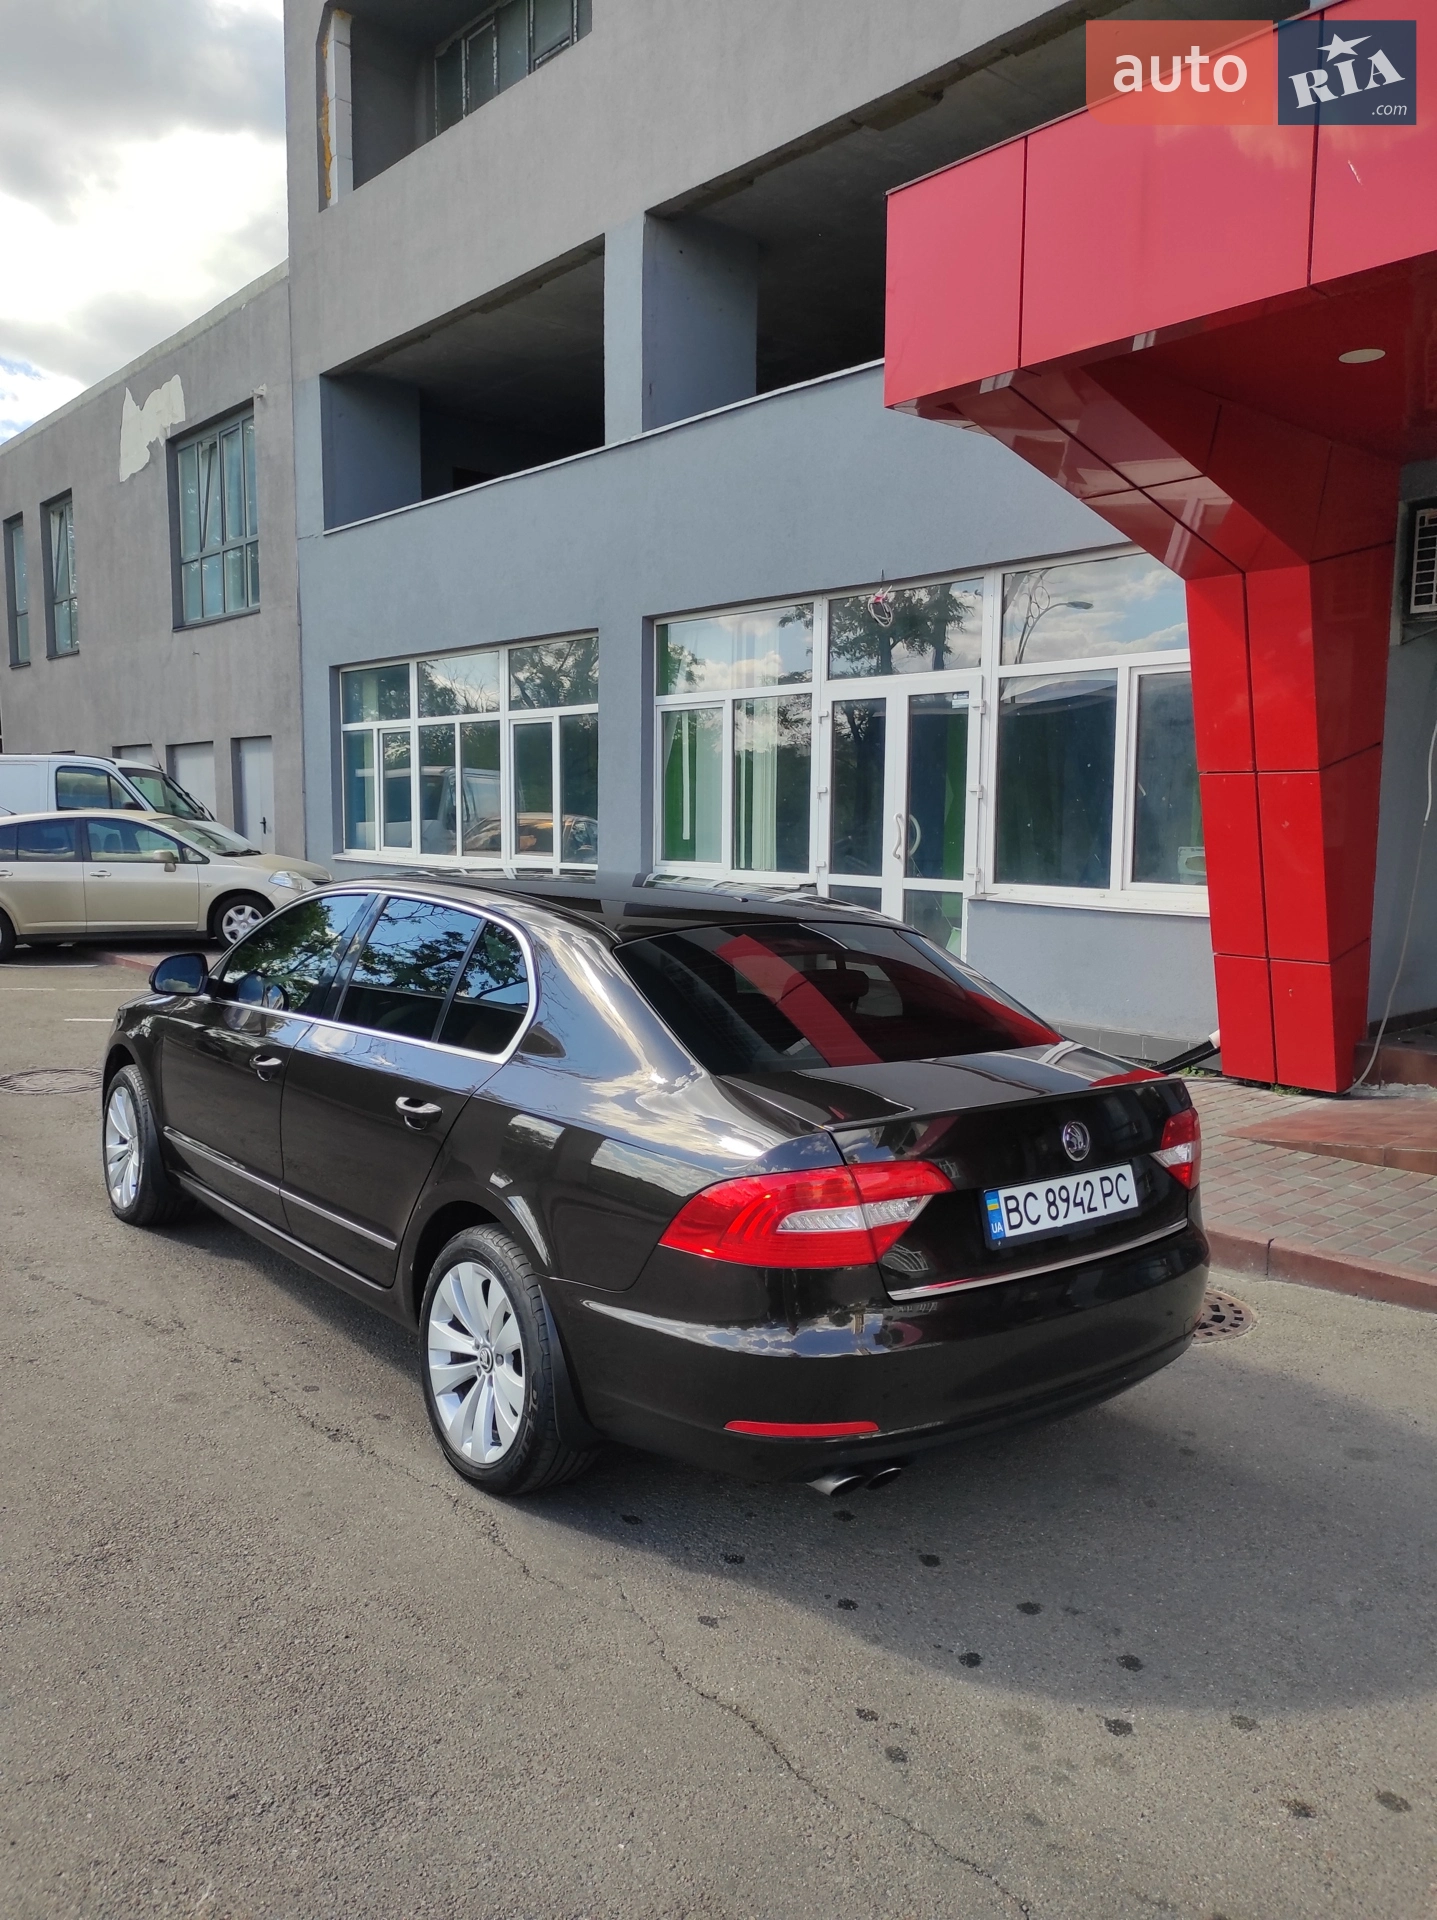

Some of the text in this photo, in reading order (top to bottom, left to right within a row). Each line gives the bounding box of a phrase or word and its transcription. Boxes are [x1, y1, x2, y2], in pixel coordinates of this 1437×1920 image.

[1003, 1172, 1130, 1231] BC 8942 PC
[991, 1221, 1004, 1234] UA
